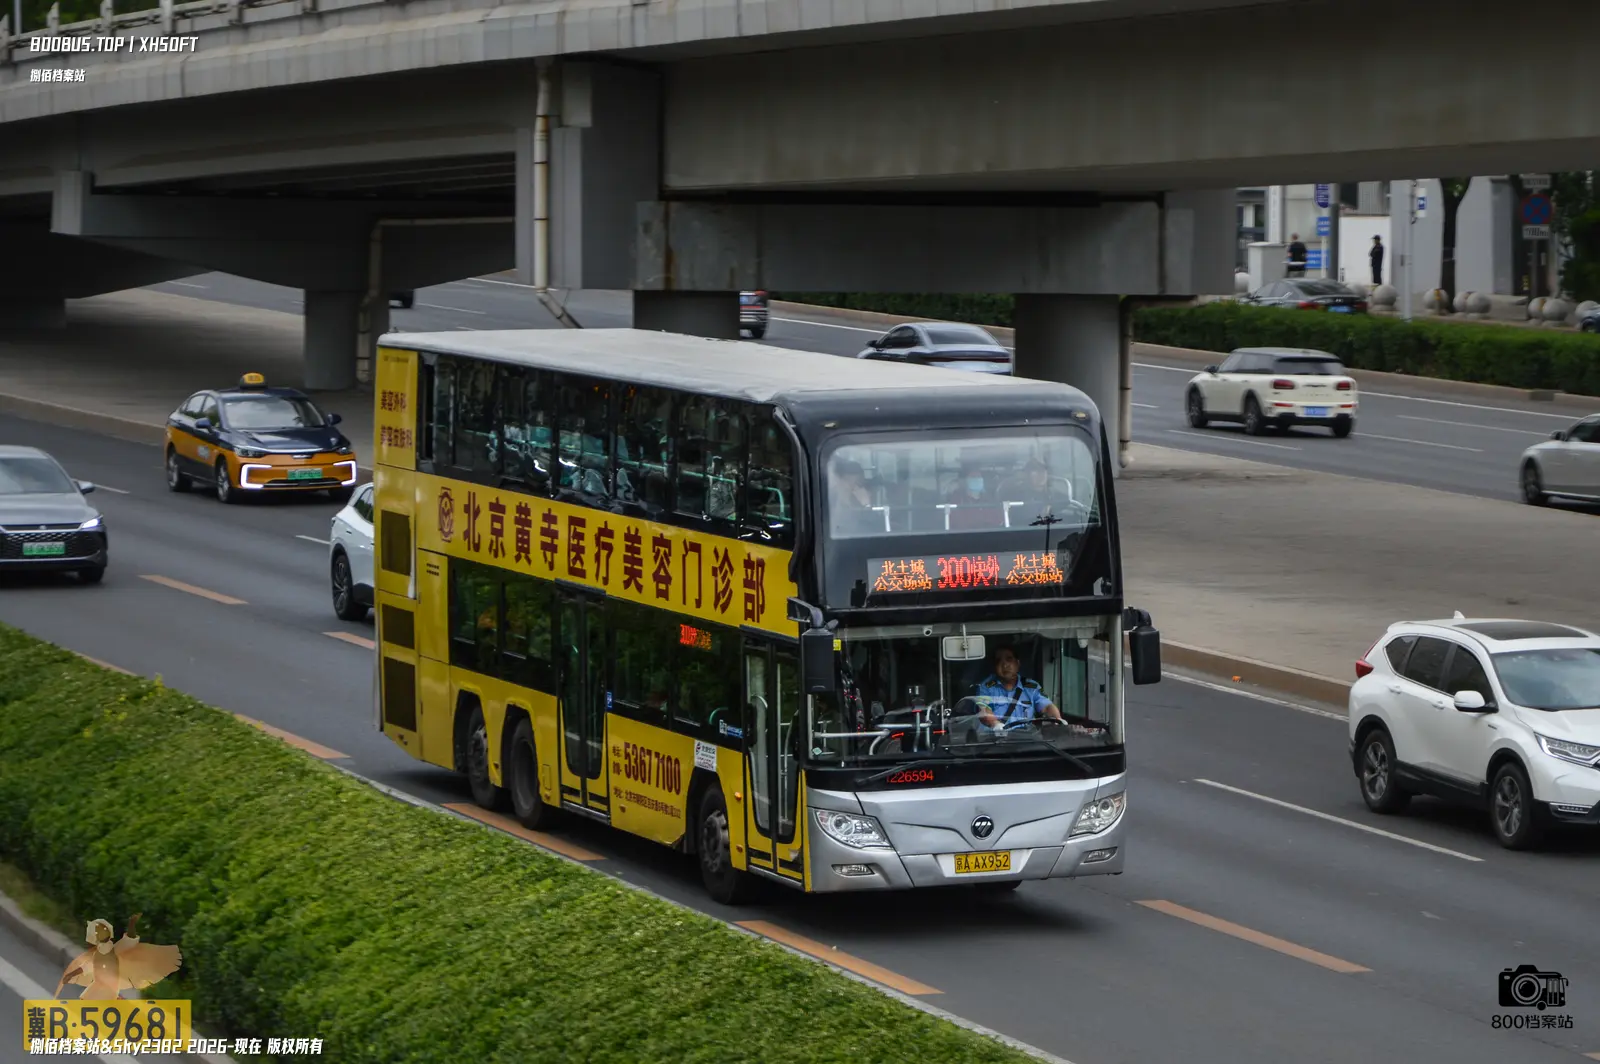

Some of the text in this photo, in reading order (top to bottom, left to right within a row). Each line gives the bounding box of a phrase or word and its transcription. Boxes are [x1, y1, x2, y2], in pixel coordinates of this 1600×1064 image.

[463, 491, 766, 623] 北京黄寺医疗美容门诊部
[1013, 552, 1057, 569] 北土城
[881, 559, 925, 576] 北土城
[937, 555, 999, 589] 300快外
[1006, 567, 1064, 585] 公交场站
[874, 573, 932, 591] 公交场站
